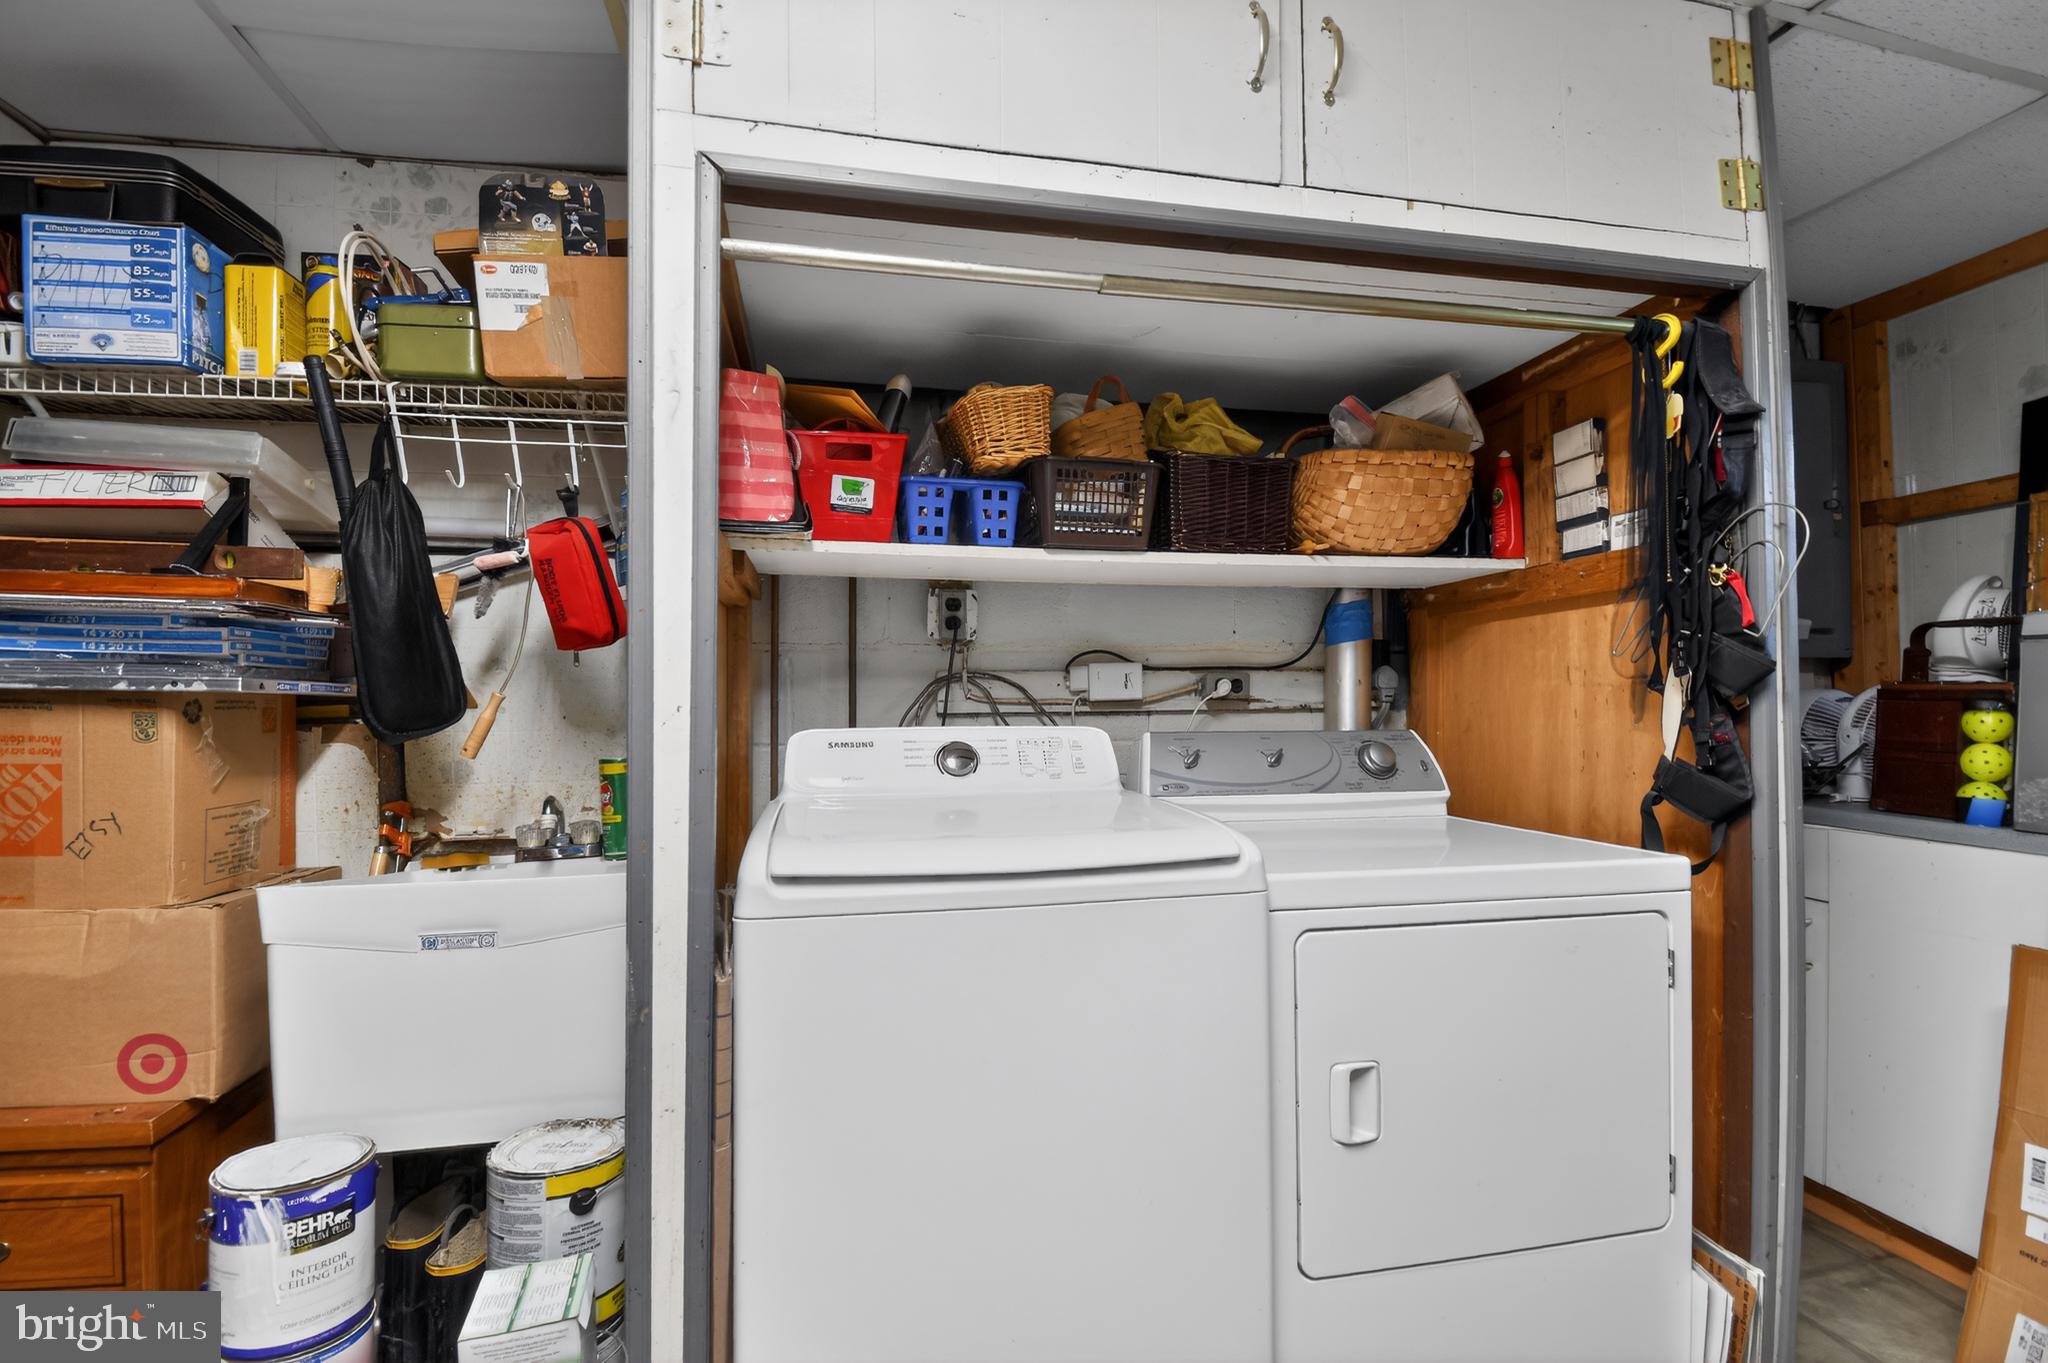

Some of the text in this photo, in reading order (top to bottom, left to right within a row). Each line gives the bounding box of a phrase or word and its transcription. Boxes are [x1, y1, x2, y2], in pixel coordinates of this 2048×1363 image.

[192, 350, 225, 376] PITCH
[31, 472, 158, 496] FILTER
[828, 741, 874, 749] SAMSUNG
[282, 1211, 334, 1241] BEHR
[287, 1228, 329, 1249] REMIUM
[278, 1256, 356, 1292] CEILING FLAT
[290, 1251, 348, 1279] INTERIOR
